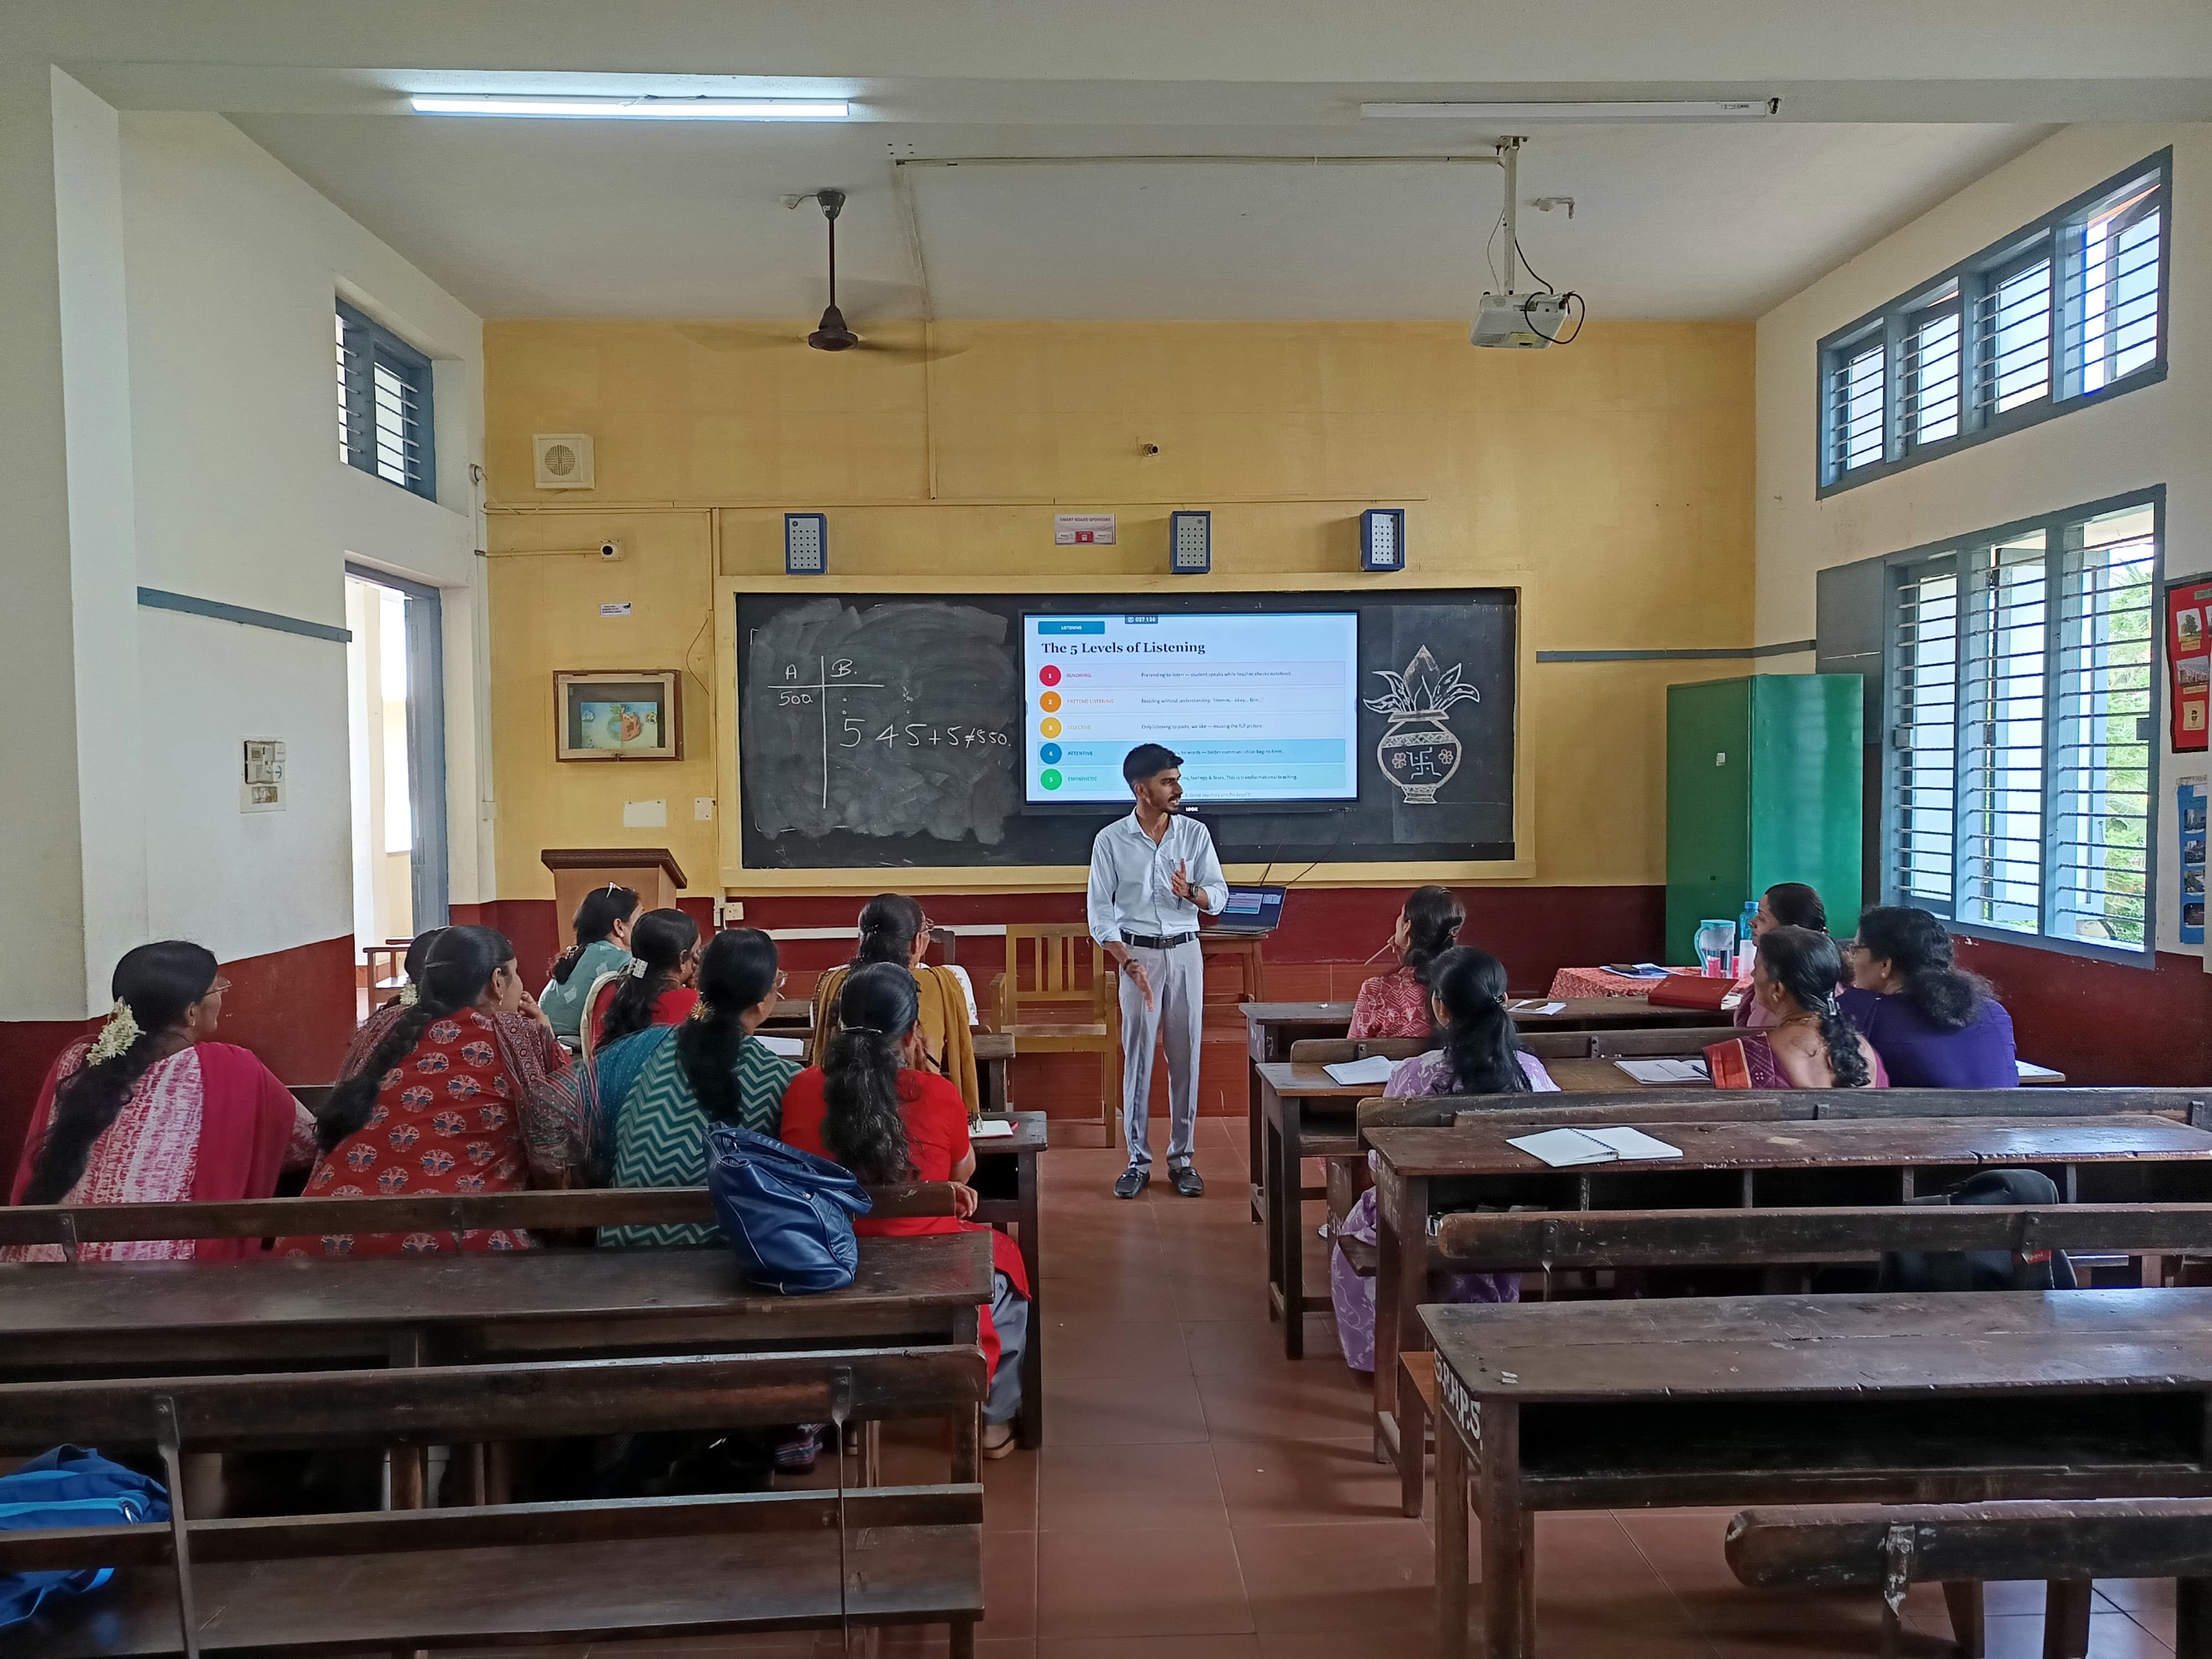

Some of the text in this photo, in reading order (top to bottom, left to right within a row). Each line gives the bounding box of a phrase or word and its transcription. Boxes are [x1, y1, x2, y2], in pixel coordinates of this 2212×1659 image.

[1042, 642, 1206, 655] The 5 Levels of Listening
[785, 664, 797, 680] A
